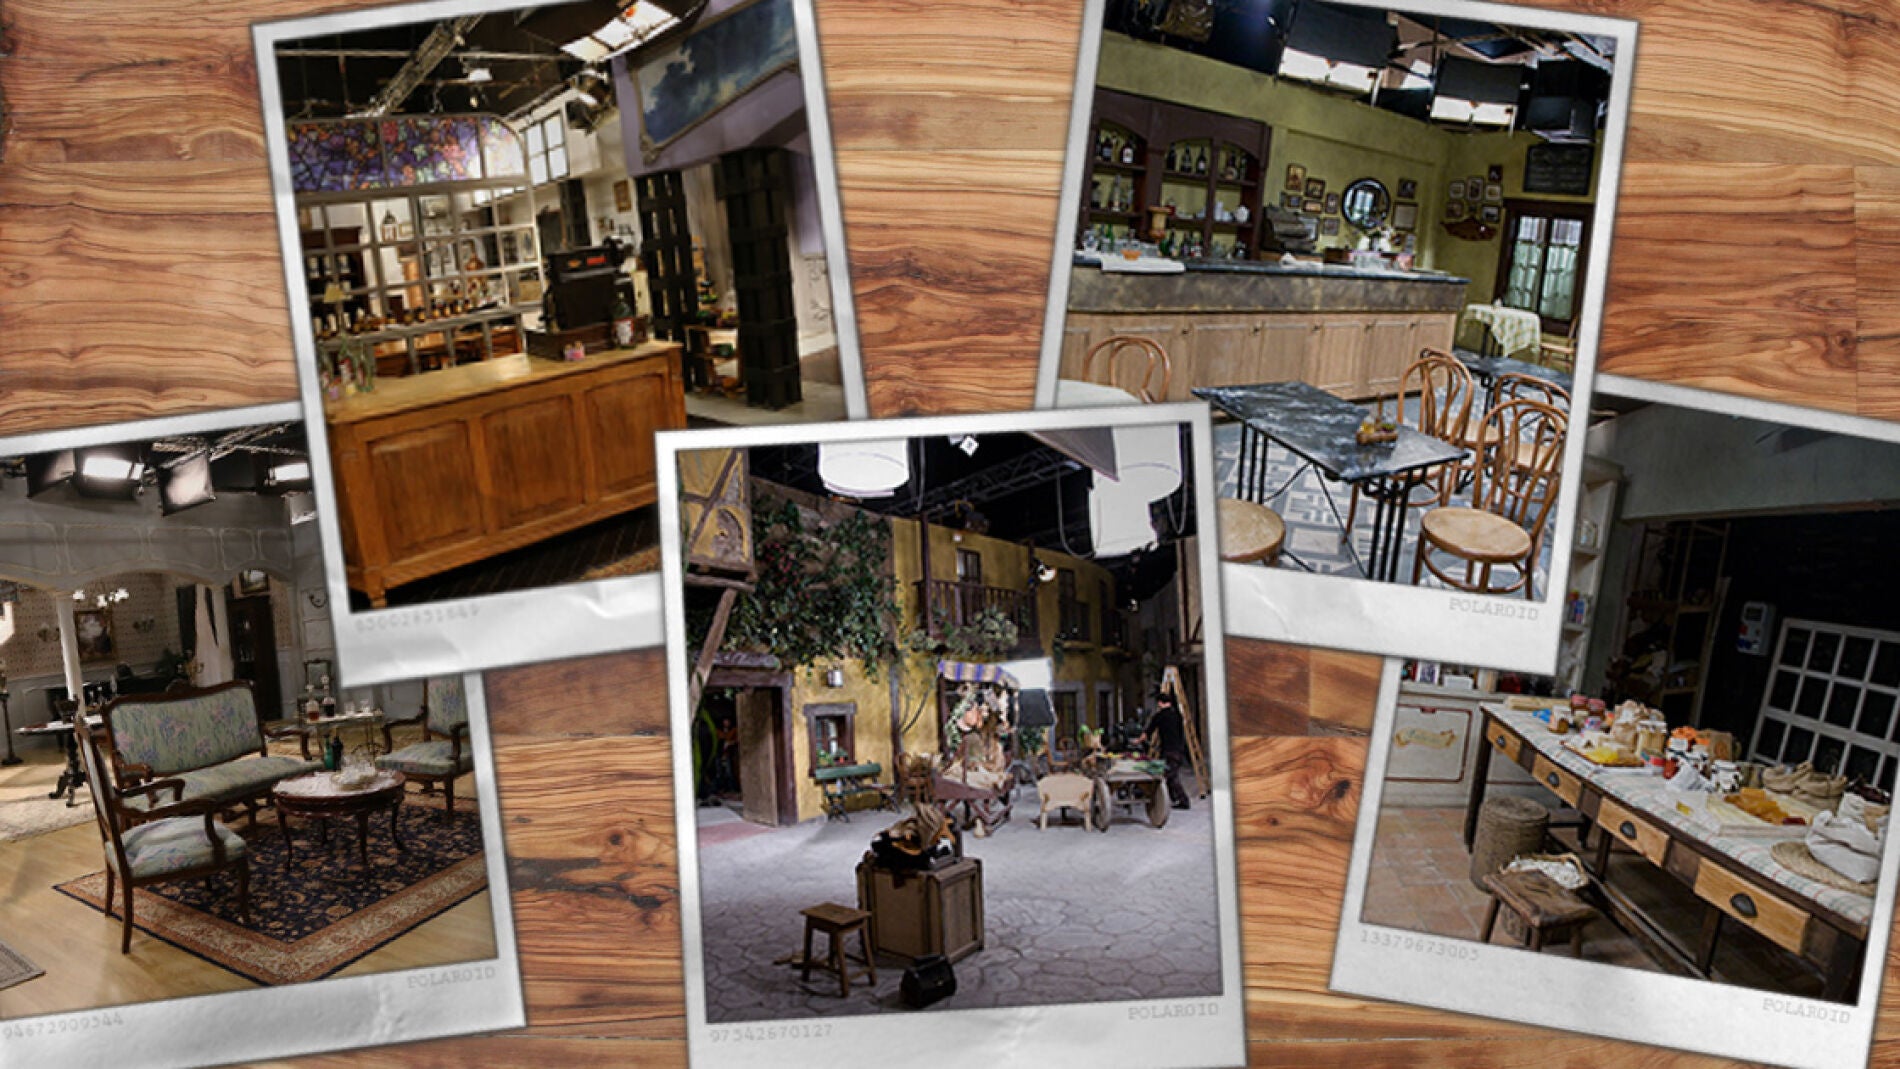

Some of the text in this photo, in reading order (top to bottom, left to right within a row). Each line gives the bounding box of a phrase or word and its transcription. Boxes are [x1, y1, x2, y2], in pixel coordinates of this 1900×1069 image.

[1449, 597, 1538, 620] POLAROID
[407, 966, 496, 989] POLAROID
[1128, 1003, 1219, 1020] POLAROID
[1763, 998, 1850, 1023] POLAROID
